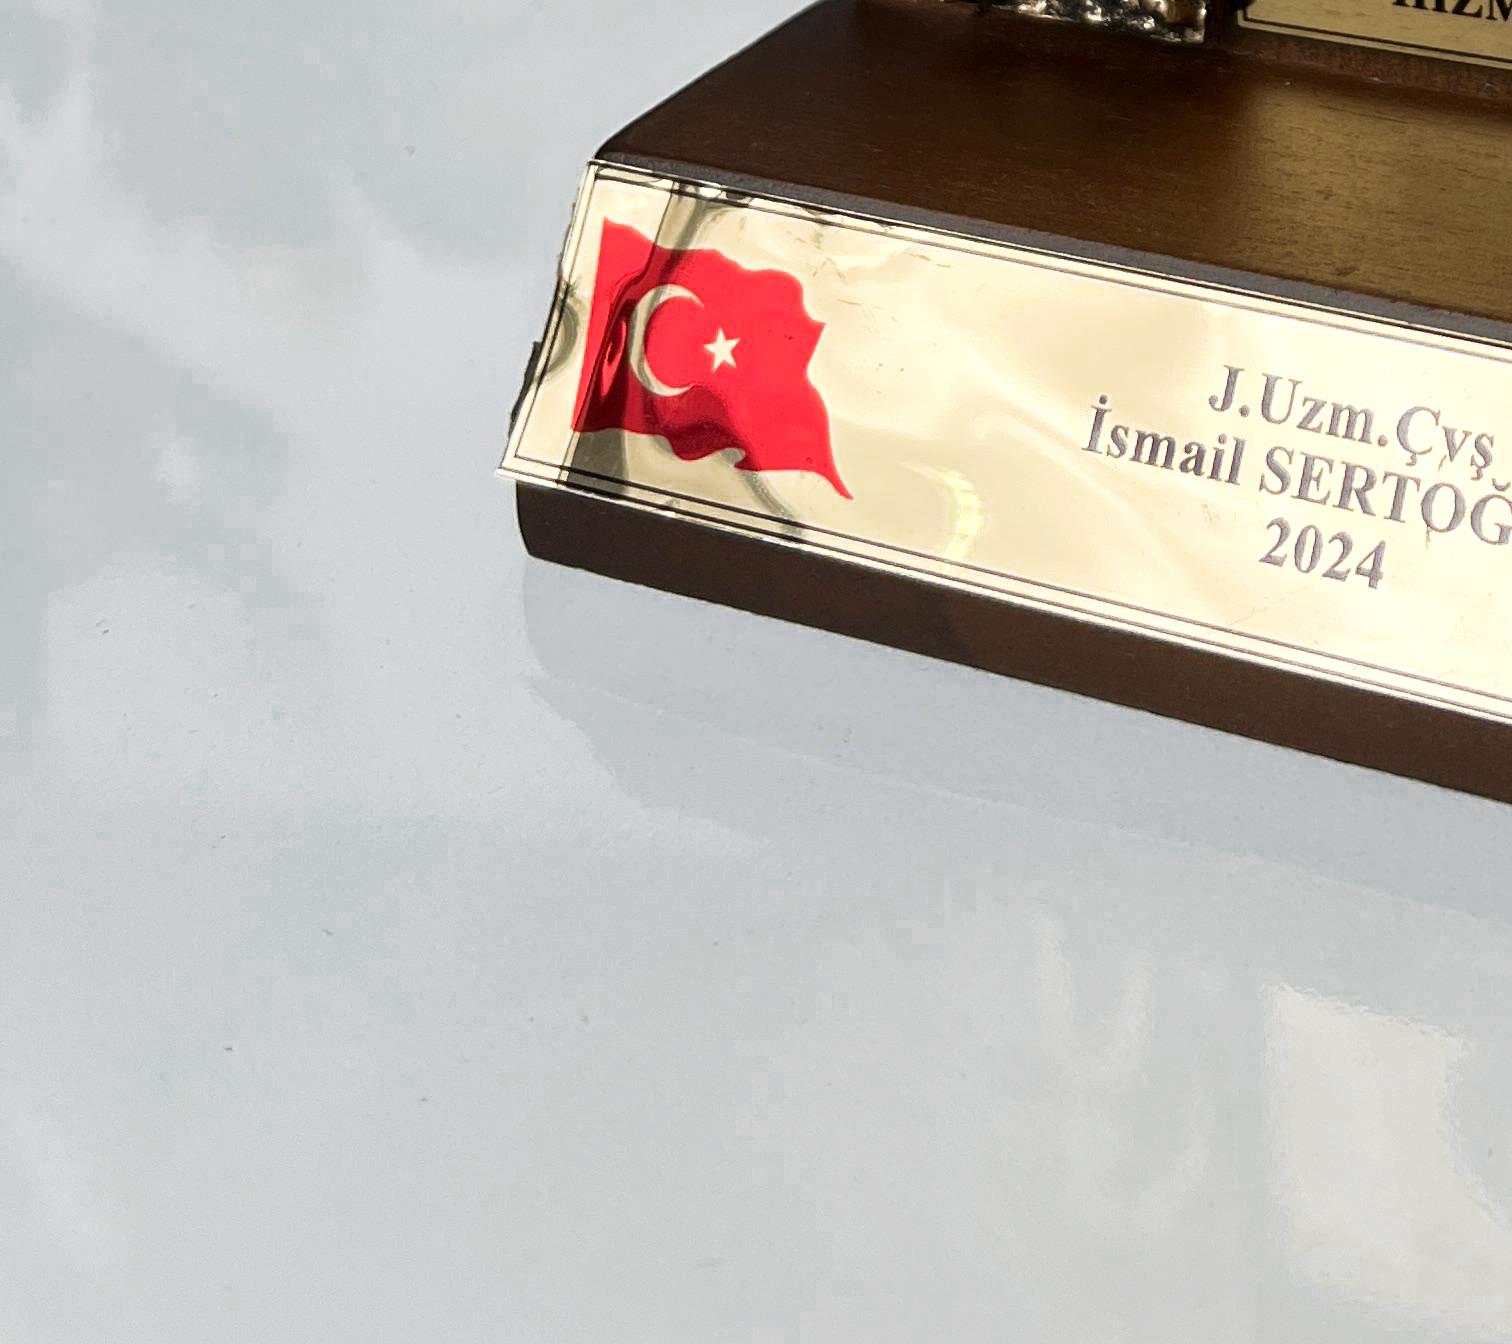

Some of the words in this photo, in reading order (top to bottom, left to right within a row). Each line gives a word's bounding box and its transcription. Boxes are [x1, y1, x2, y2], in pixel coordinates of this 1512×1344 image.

[1081, 395, 1246, 485] İsmail
[1207, 365, 1494, 479] J.Uzm.Çvş
[1259, 518, 1385, 589] 2024
